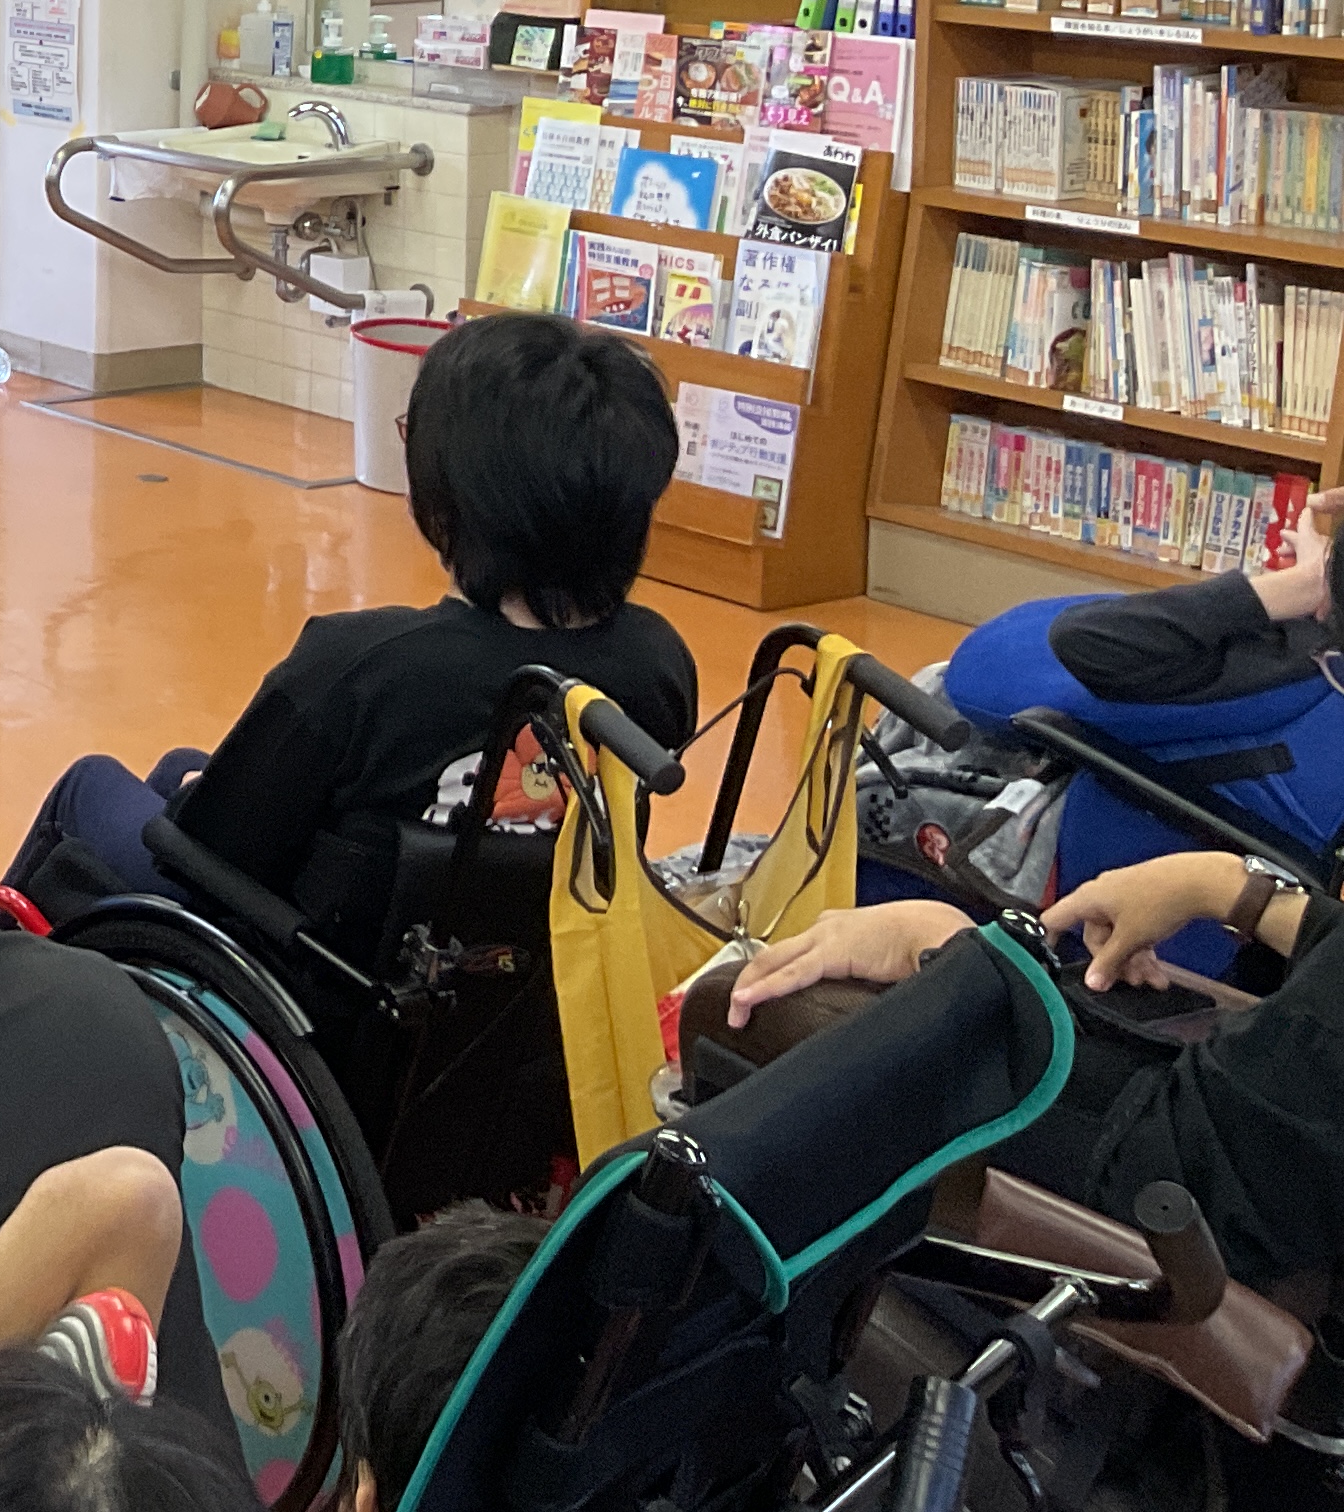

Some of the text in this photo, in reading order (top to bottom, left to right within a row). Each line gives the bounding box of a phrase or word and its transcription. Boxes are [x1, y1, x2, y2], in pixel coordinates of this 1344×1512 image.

[822, 144, 857, 163] あわわ
[741, 248, 798, 274] 著作権
